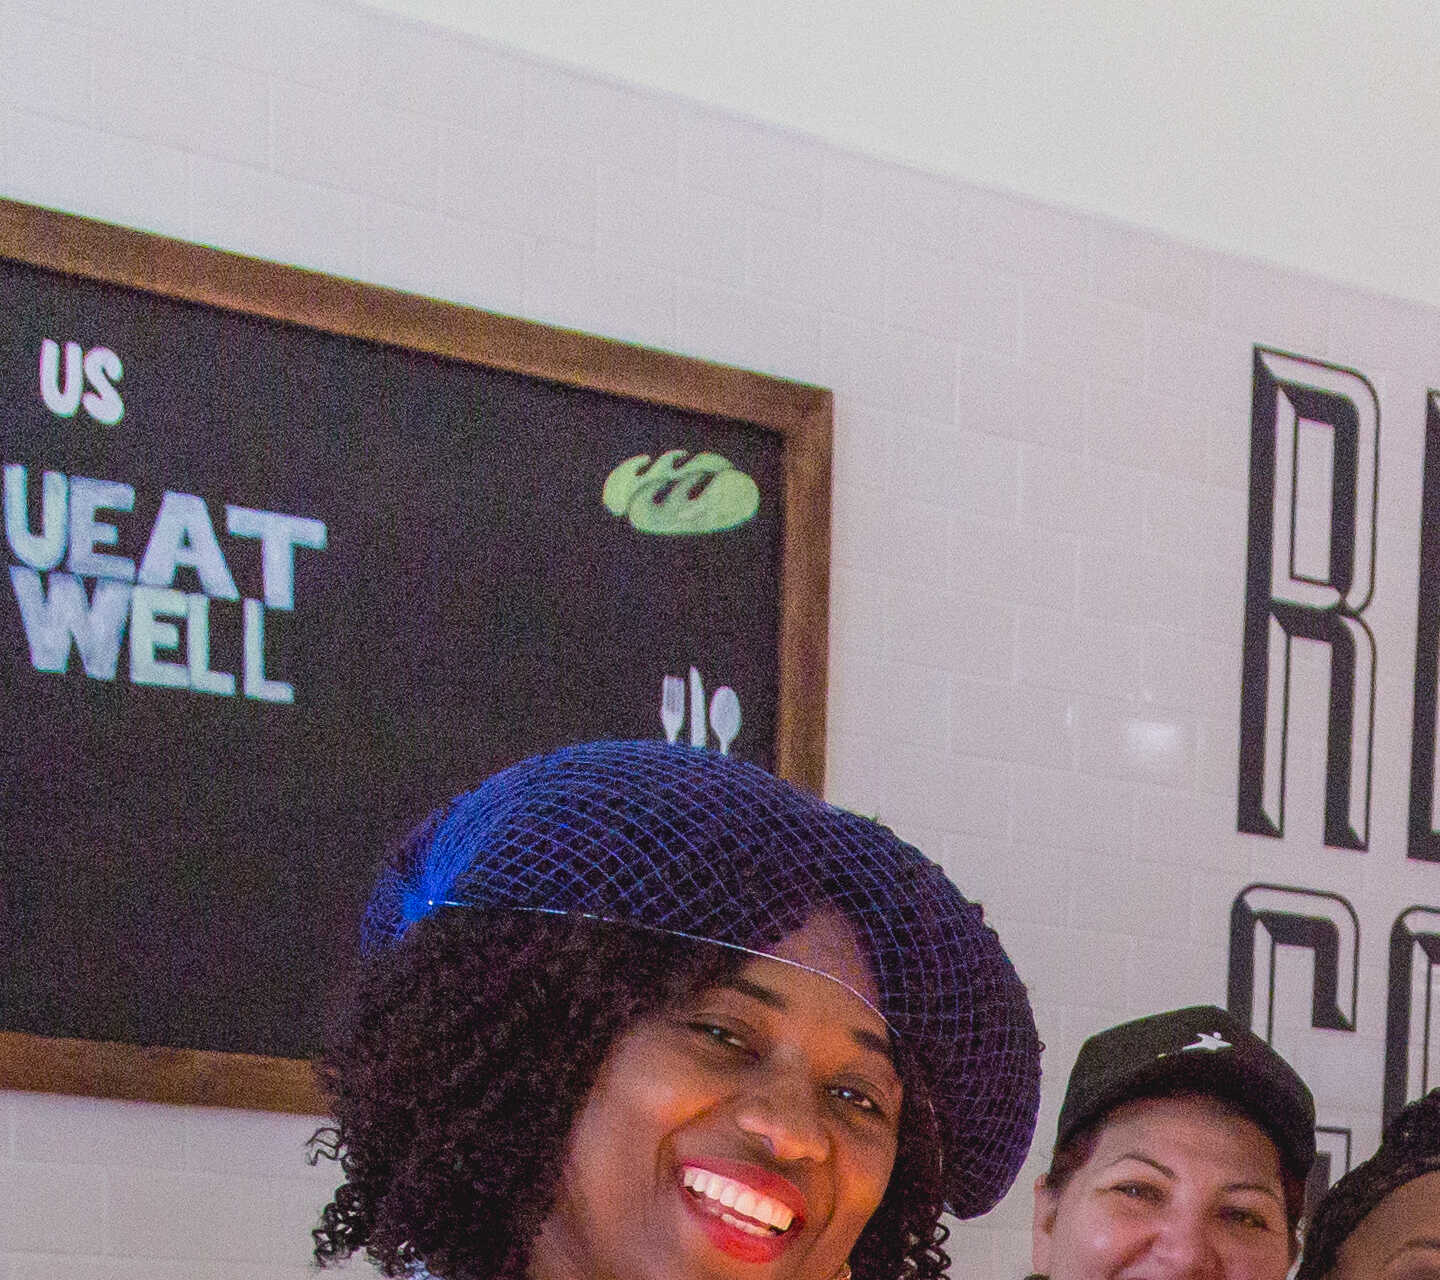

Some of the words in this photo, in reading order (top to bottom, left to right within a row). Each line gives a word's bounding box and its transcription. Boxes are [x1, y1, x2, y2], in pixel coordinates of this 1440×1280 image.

[39, 338, 125, 426] US
[4, 463, 327, 611] UEAT
[10, 565, 295, 704] WELL
